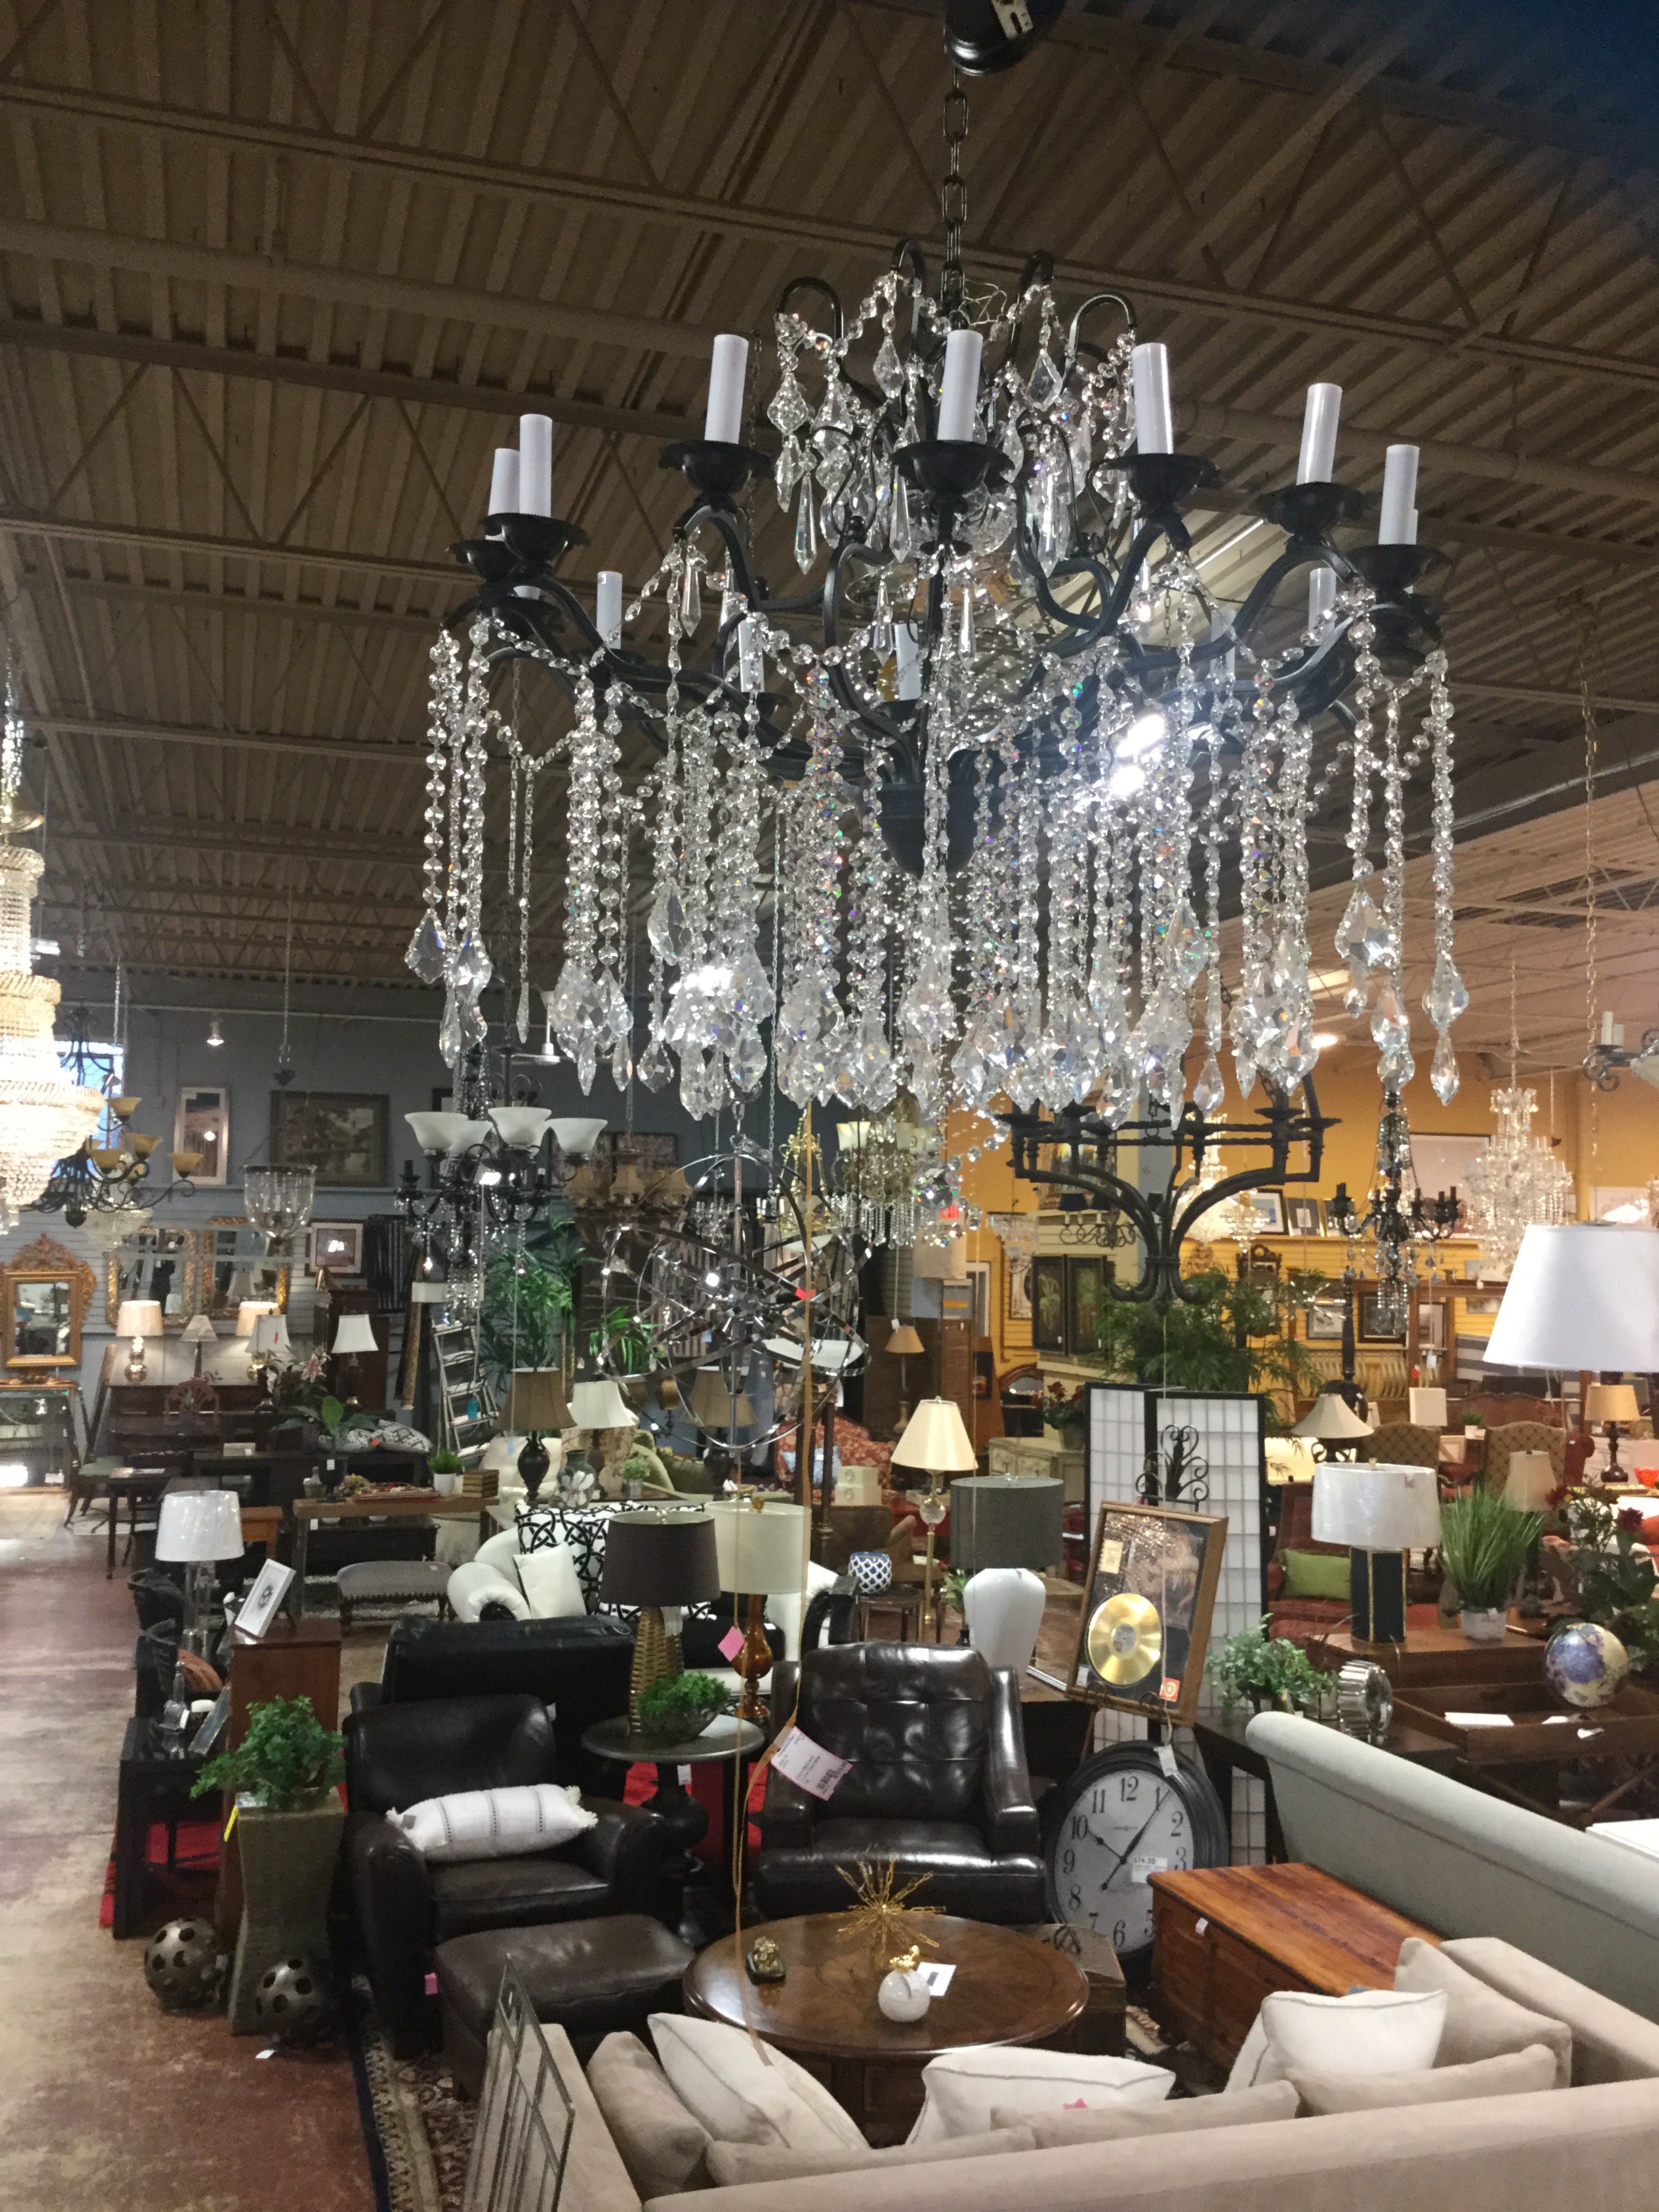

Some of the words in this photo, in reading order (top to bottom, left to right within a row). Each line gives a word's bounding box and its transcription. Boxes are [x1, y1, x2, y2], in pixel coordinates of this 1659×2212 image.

[1092, 1789, 1105, 1813] 11
[1121, 1776, 1139, 1801] 12
[1155, 1786, 1162, 1811] 1
[1071, 1815, 1088, 1840] 10
[1170, 1810, 1184, 1837] 2
[1063, 1849, 1076, 1875] 9
[1175, 1847, 1187, 1870] 3
[1069, 1885, 1082, 1910] 8
[1113, 1919, 1126, 1947] 6
